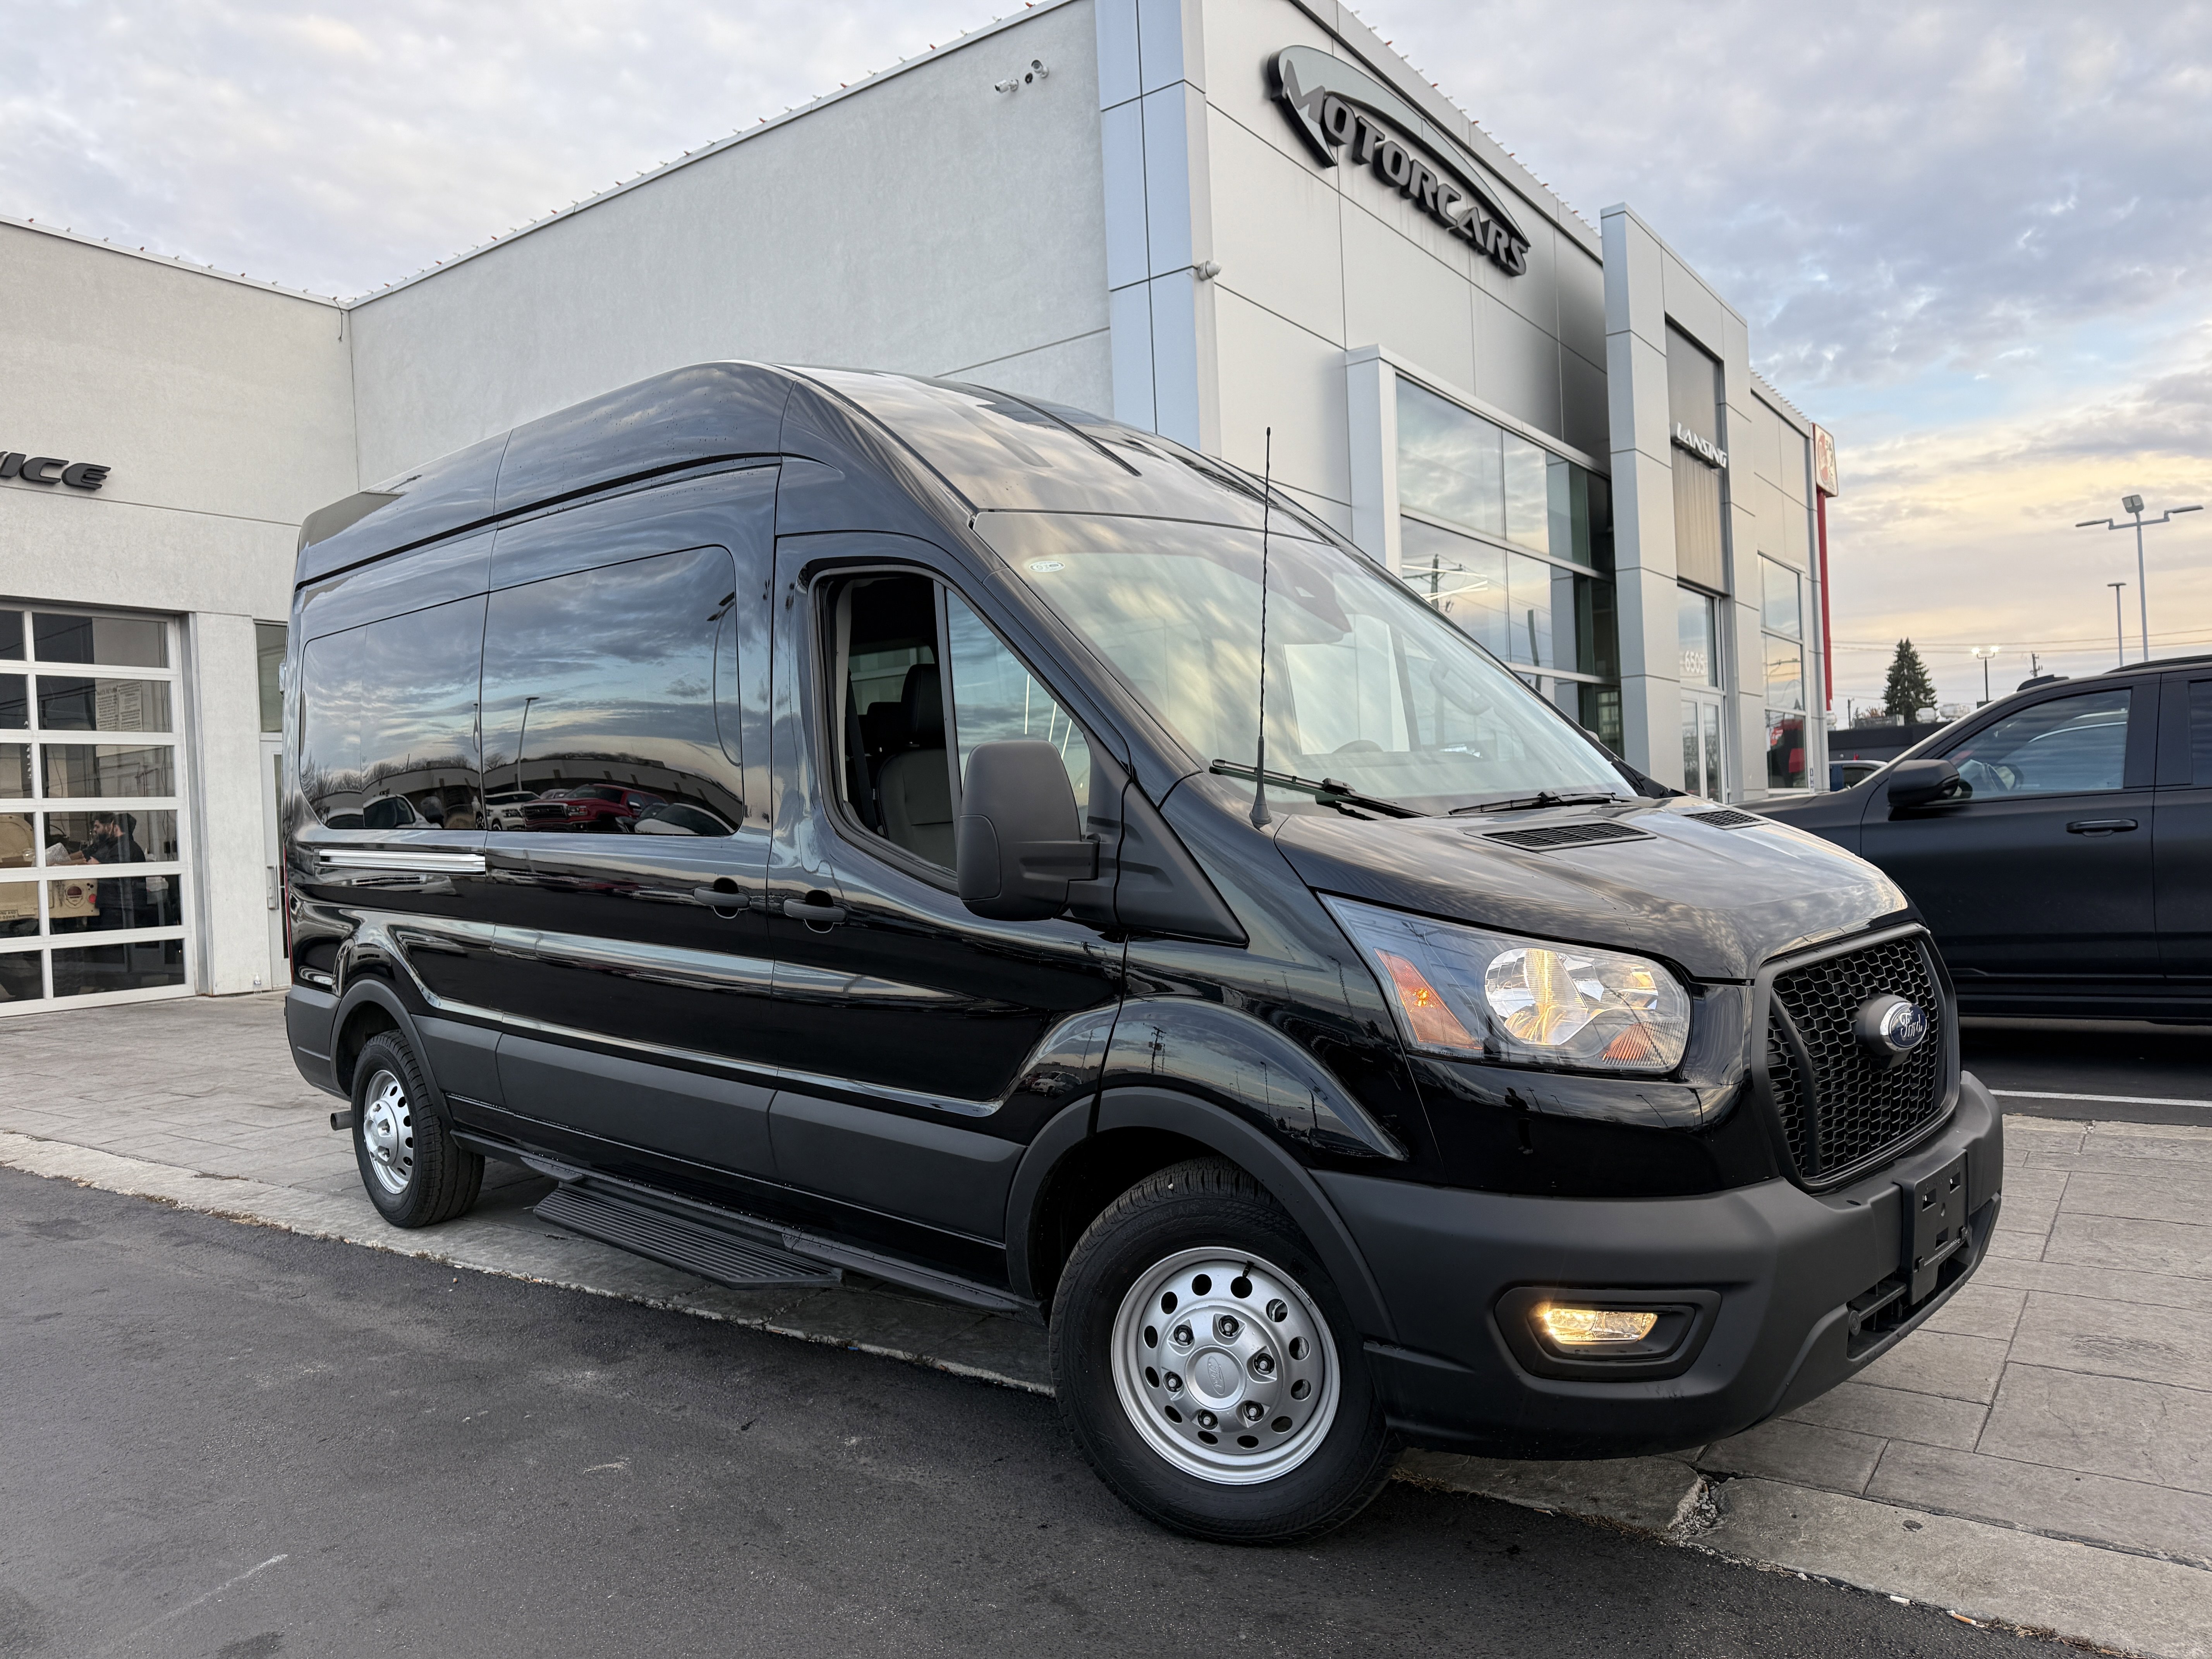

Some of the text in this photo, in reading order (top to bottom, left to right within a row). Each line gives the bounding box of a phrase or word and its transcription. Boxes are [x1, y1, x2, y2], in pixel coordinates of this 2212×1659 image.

[1283, 60, 1527, 276] MOTORCARS
[1677, 422, 1726, 468] LANSING
[0, 451, 111, 490] ICE
[1685, 651, 1705, 673] 6505
[1899, 1010, 1923, 1037] Ford
